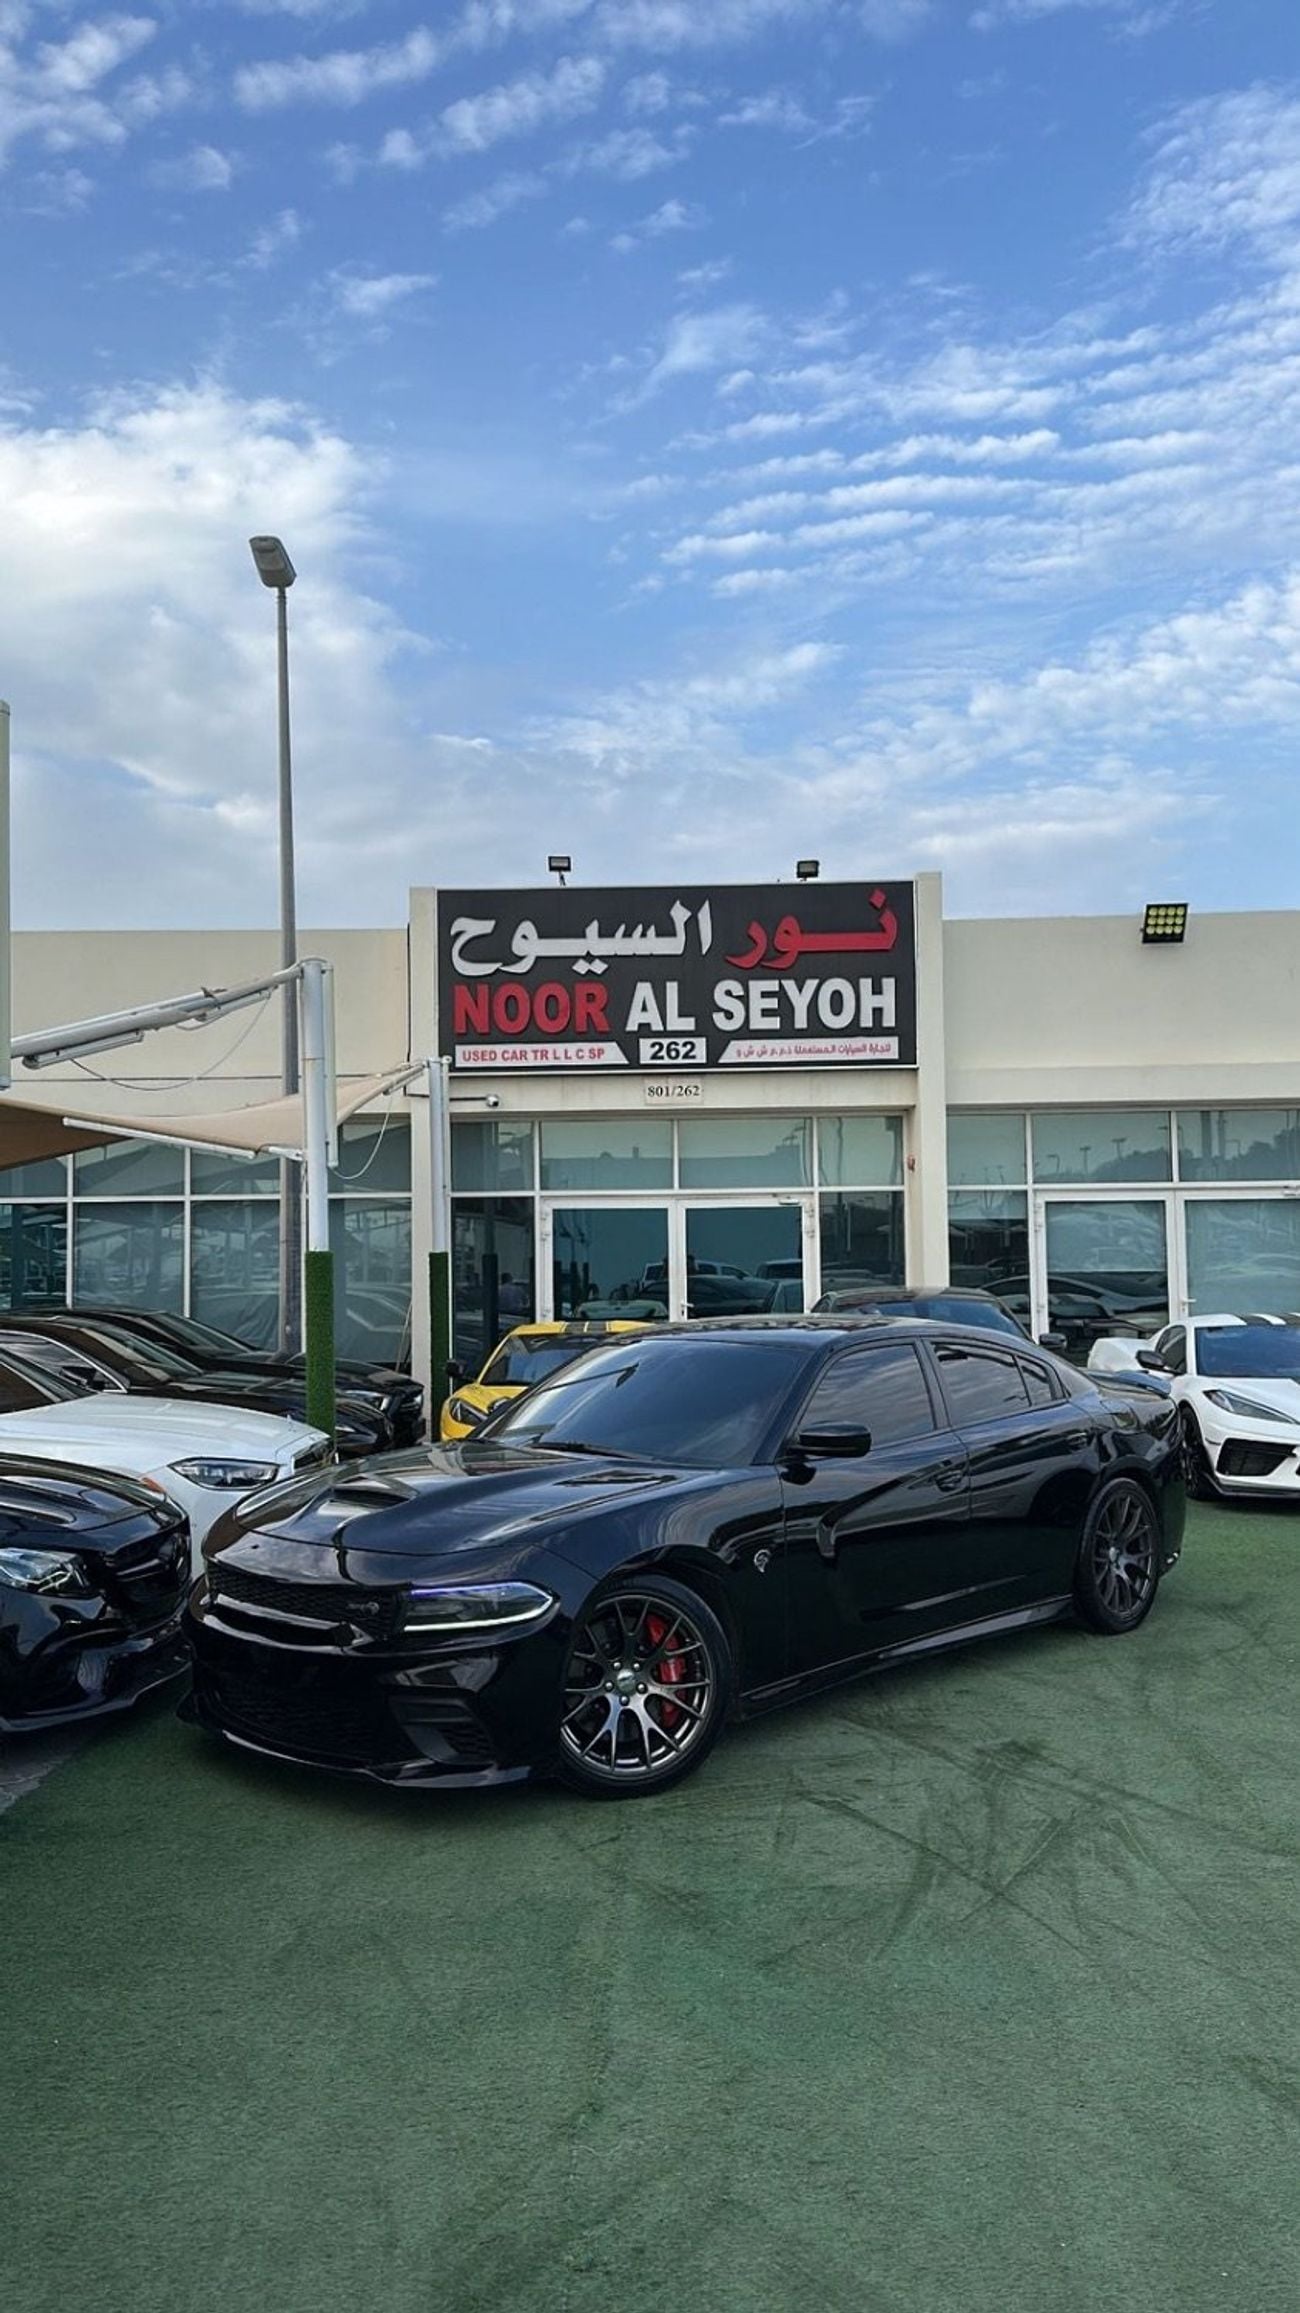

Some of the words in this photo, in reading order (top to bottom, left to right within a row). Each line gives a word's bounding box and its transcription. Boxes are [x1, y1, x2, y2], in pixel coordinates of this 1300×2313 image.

[450, 899, 712, 976] السيوح
[725, 889, 898, 970] نور
[453, 981, 611, 1034] NOOR
[626, 981, 695, 1032] AL
[712, 976, 896, 1031] SEYOH
[462, 1050, 497, 1062] USED
[501, 1049, 528, 1061] CAR
[532, 1049, 549, 1061] TR
[589, 1047, 605, 1060] SP
[649, 1041, 697, 1061] 262
[647, 1085, 700, 1098] 801/262
